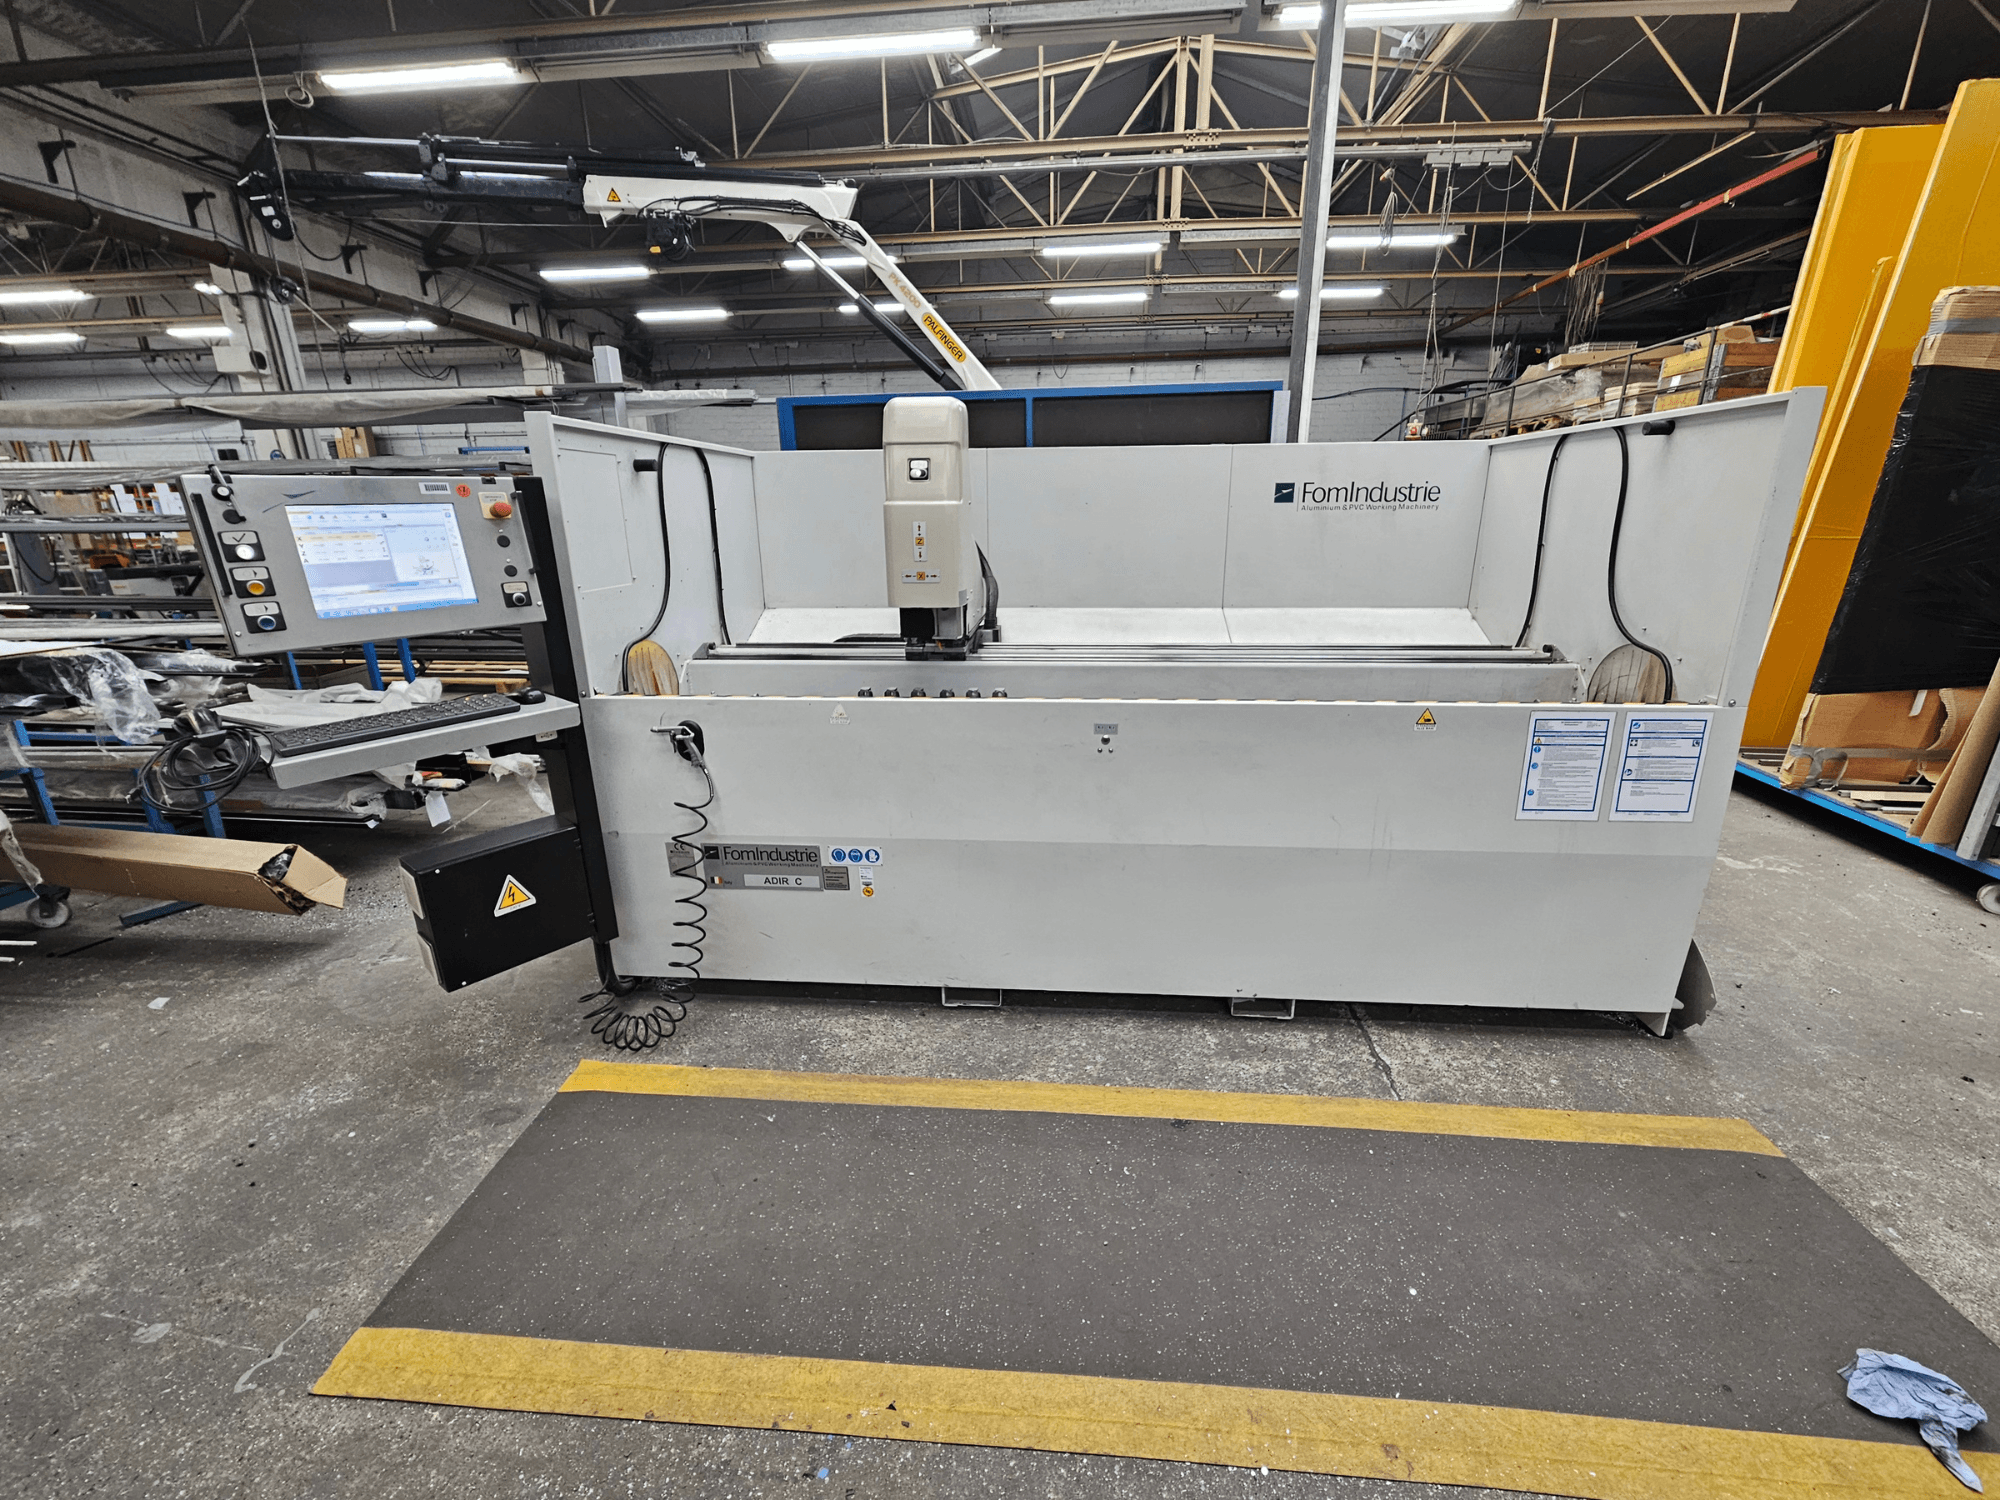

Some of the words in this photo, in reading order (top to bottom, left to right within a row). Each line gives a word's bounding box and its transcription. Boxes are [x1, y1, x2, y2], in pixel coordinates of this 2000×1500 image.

[889, 273, 901, 286] PK
[923, 315, 963, 360] PALFINGER
[1301, 480, 1441, 504] FomIndustrie
[1365, 503, 1397, 512] Working
[1397, 503, 1440, 511] Machinery
[723, 846, 818, 862] FomIndustrie
[763, 876, 789, 886] ADIR
[794, 877, 803, 886] C
